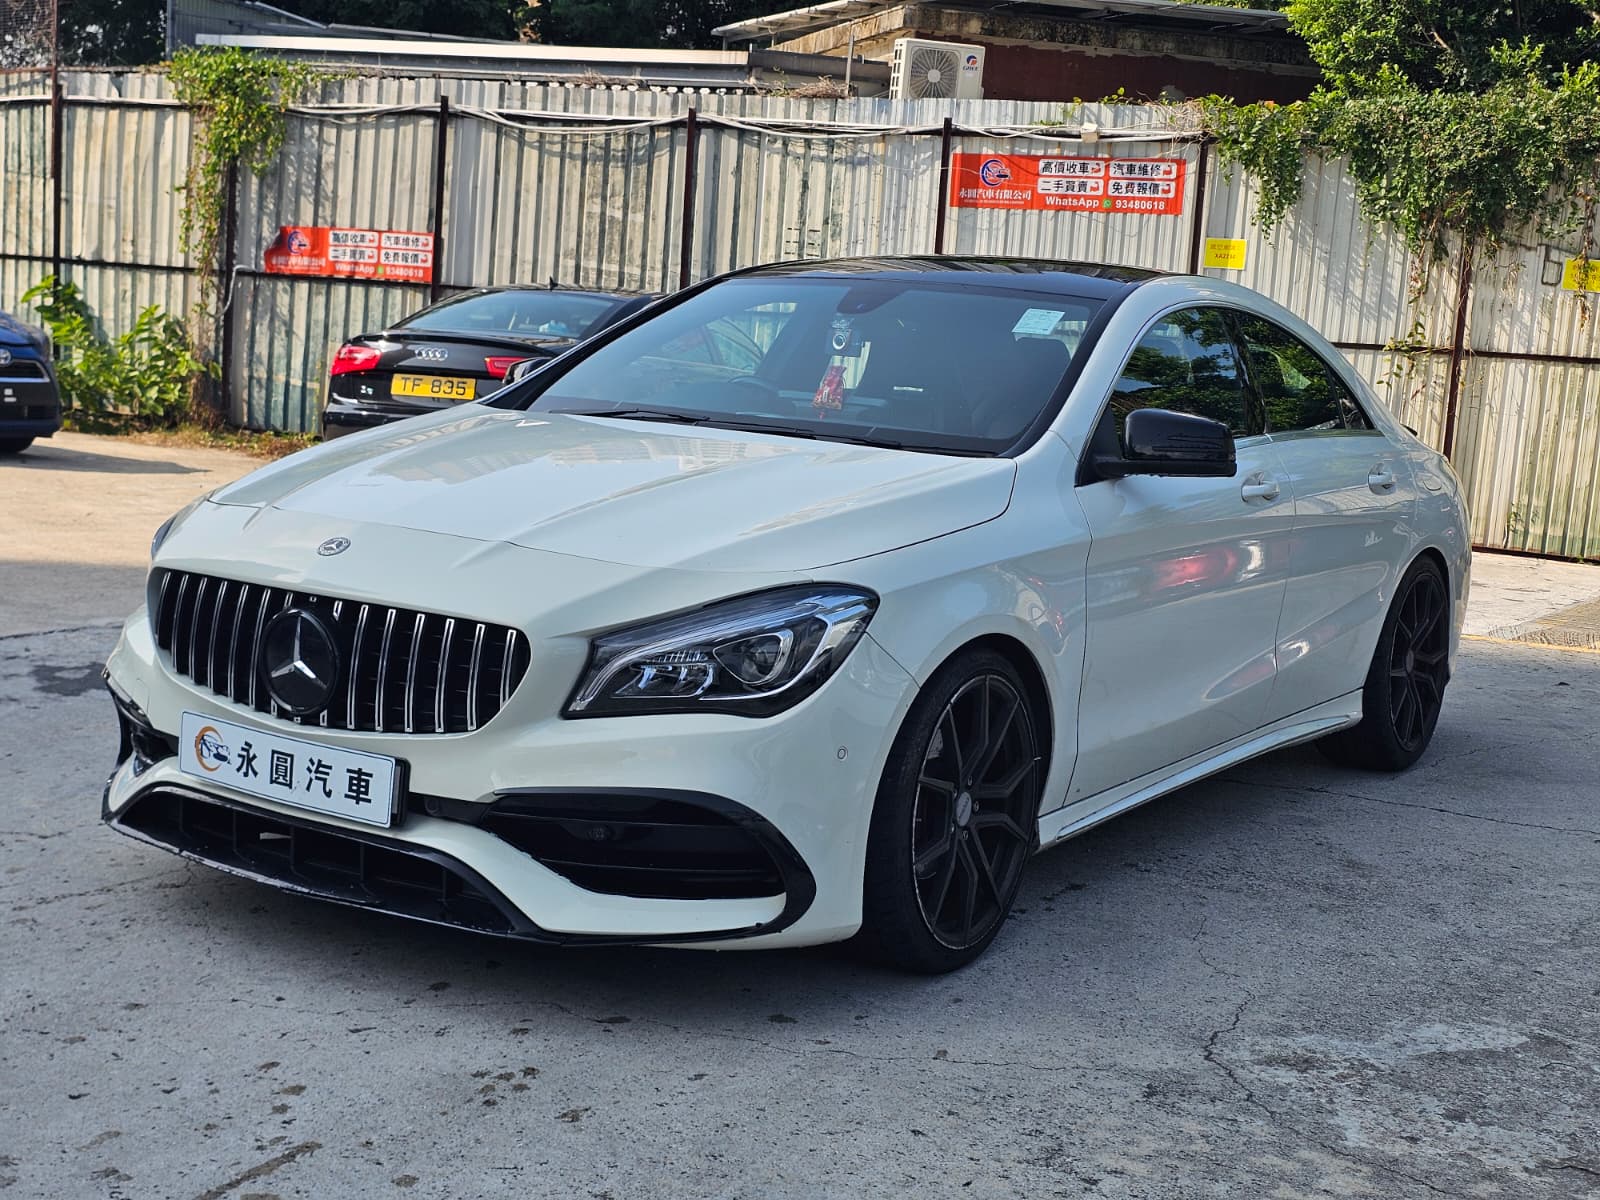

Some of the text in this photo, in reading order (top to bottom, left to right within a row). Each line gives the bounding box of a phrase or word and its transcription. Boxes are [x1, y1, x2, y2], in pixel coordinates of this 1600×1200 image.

[1042, 161, 1089, 174] 高價收車
[1113, 163, 1161, 176] 汽車維修
[1040, 180, 1088, 193] 二手買賣
[1112, 182, 1160, 195] 免費報價
[1045, 196, 1165, 210] WhatsApp 93480618
[401, 376, 467, 396] TF 835
[236, 741, 374, 805] 永圓汽車
